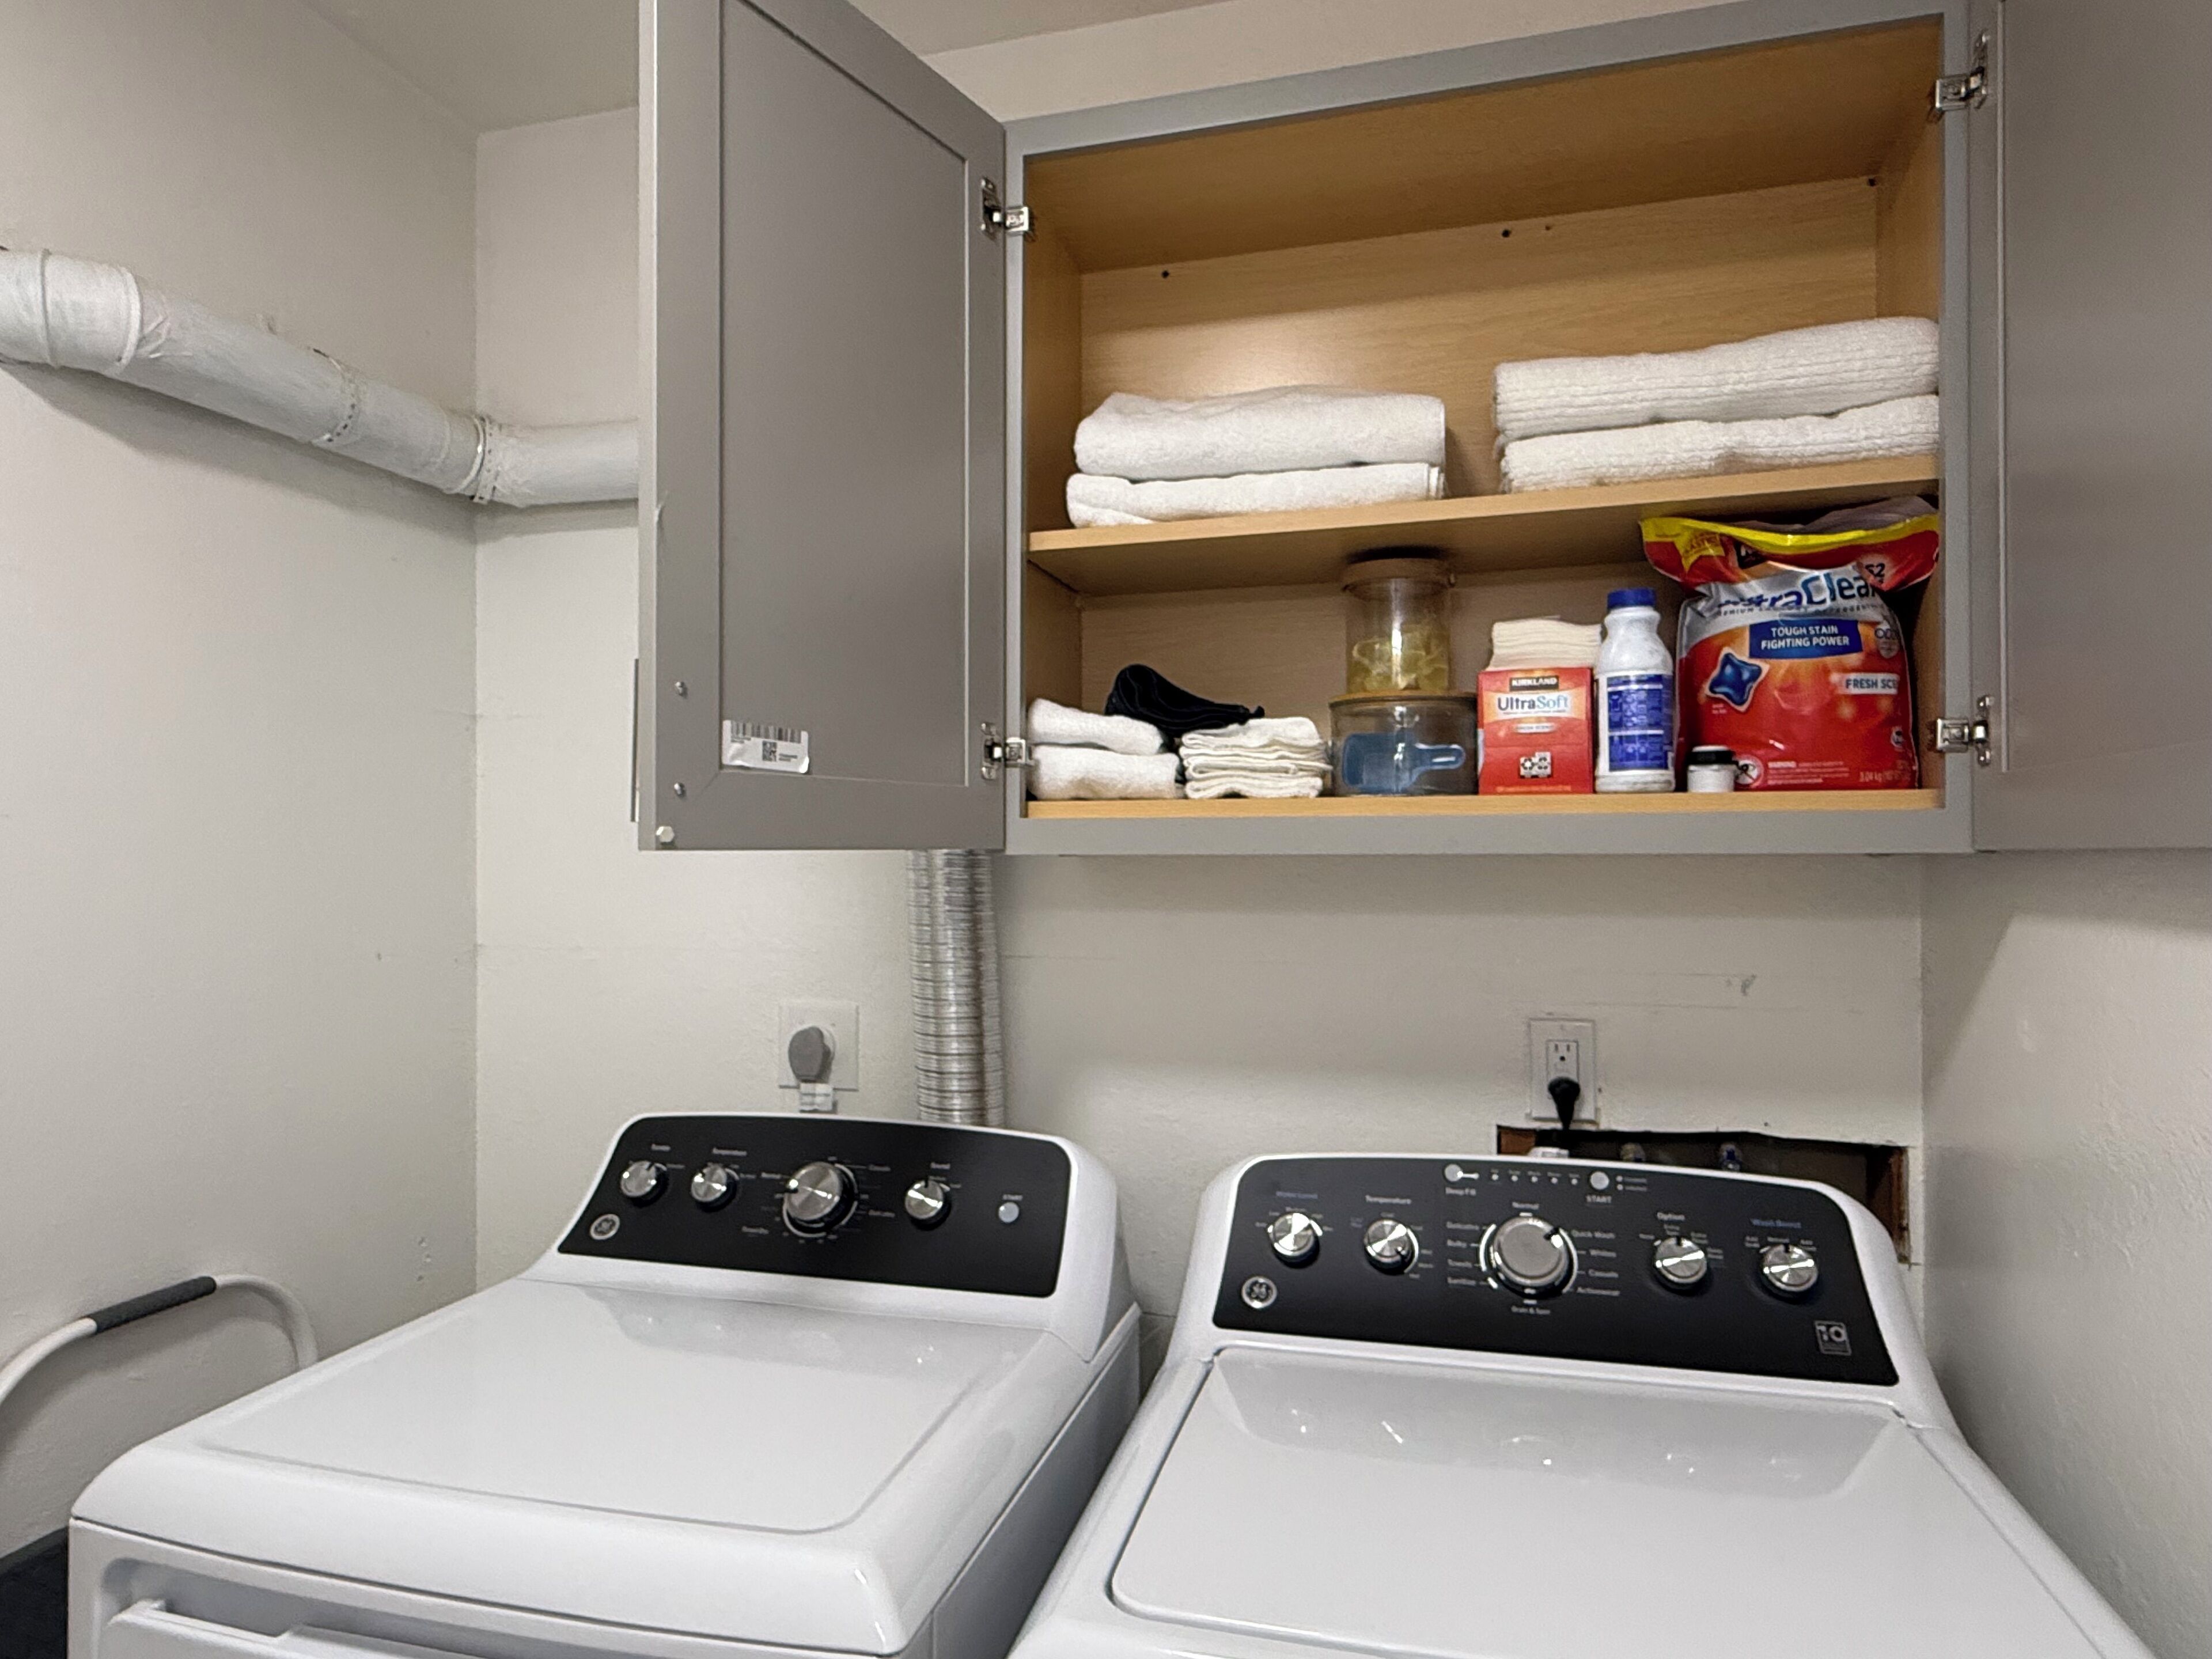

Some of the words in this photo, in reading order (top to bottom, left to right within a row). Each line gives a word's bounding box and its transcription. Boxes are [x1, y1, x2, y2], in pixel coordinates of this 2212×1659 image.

[1770, 626, 1807, 637] TOUGH
[1808, 624, 1839, 635] STAIN
[1761, 637, 1810, 650] FIGHTING
[1812, 635, 1850, 646] POWER
[1846, 678, 1878, 689] FRESH
[1497, 694, 1569, 711] UltraSoft
